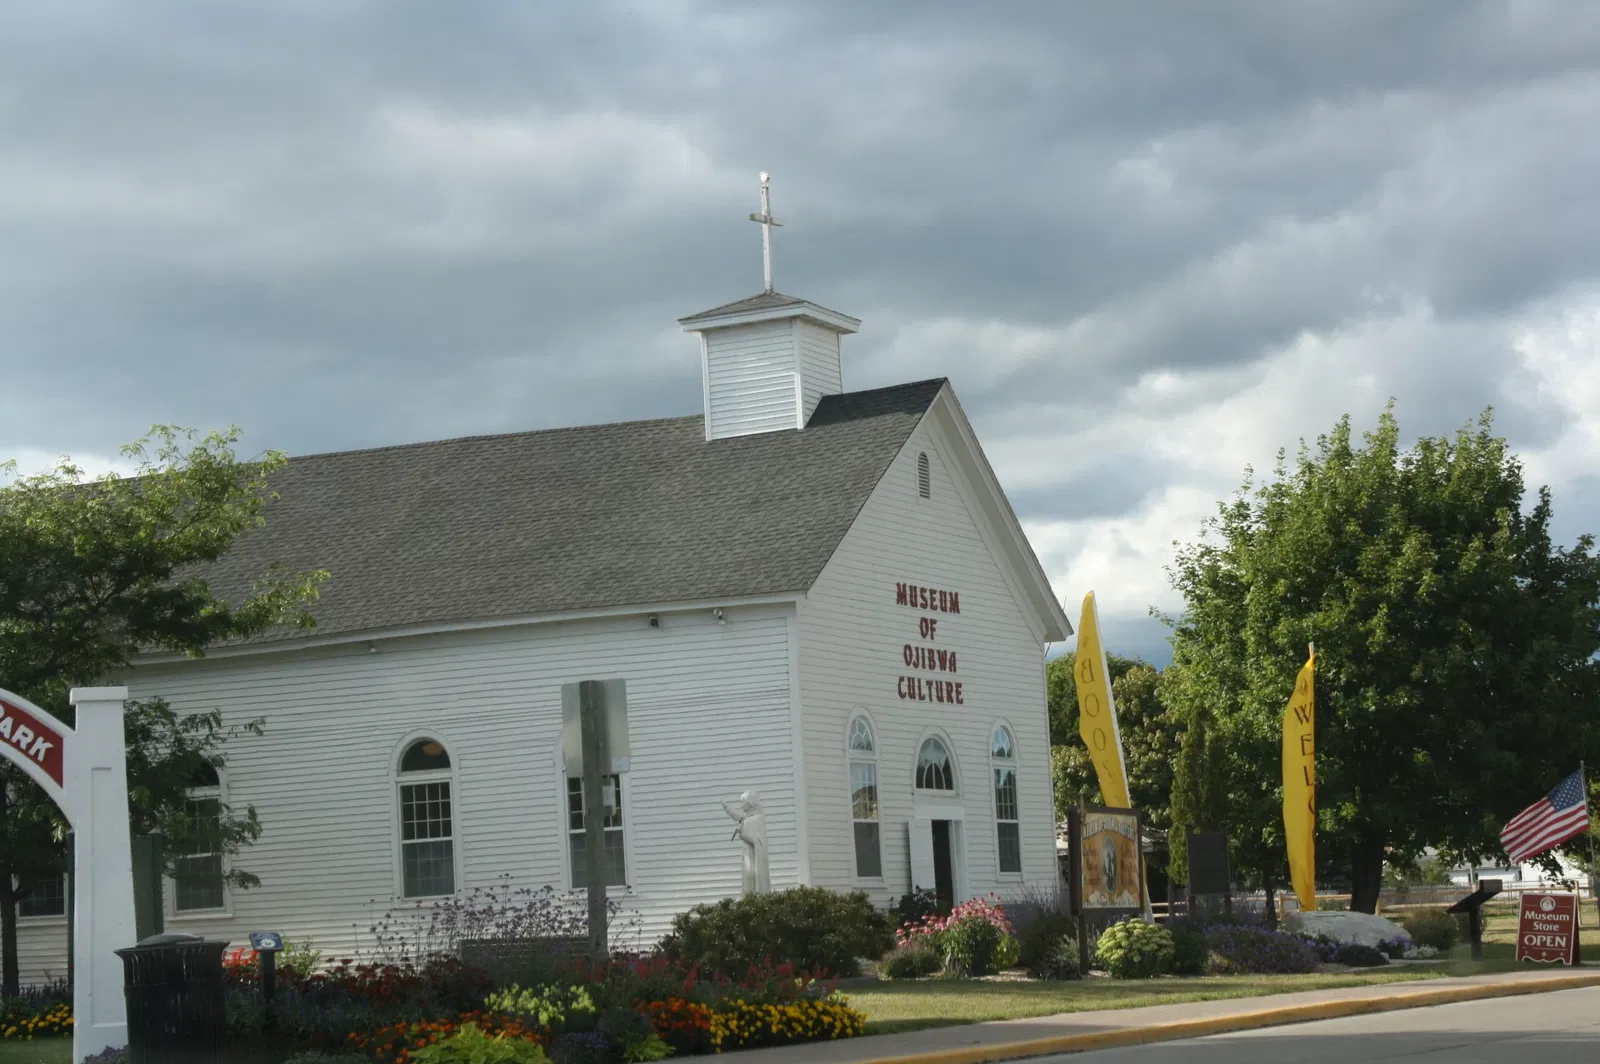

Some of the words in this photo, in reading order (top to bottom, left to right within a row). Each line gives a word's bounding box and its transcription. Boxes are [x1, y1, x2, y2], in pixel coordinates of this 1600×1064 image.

[896, 582, 960, 614] MUSEUM
[919, 616, 937, 640] OF
[903, 644, 957, 673] OJIBWA
[897, 676, 964, 705] CULTURE
[0, 703, 54, 762] ARK
[1524, 910, 1570, 921] Museum
[1533, 921, 1559, 931] Store
[1524, 934, 1566, 948] OPEN
